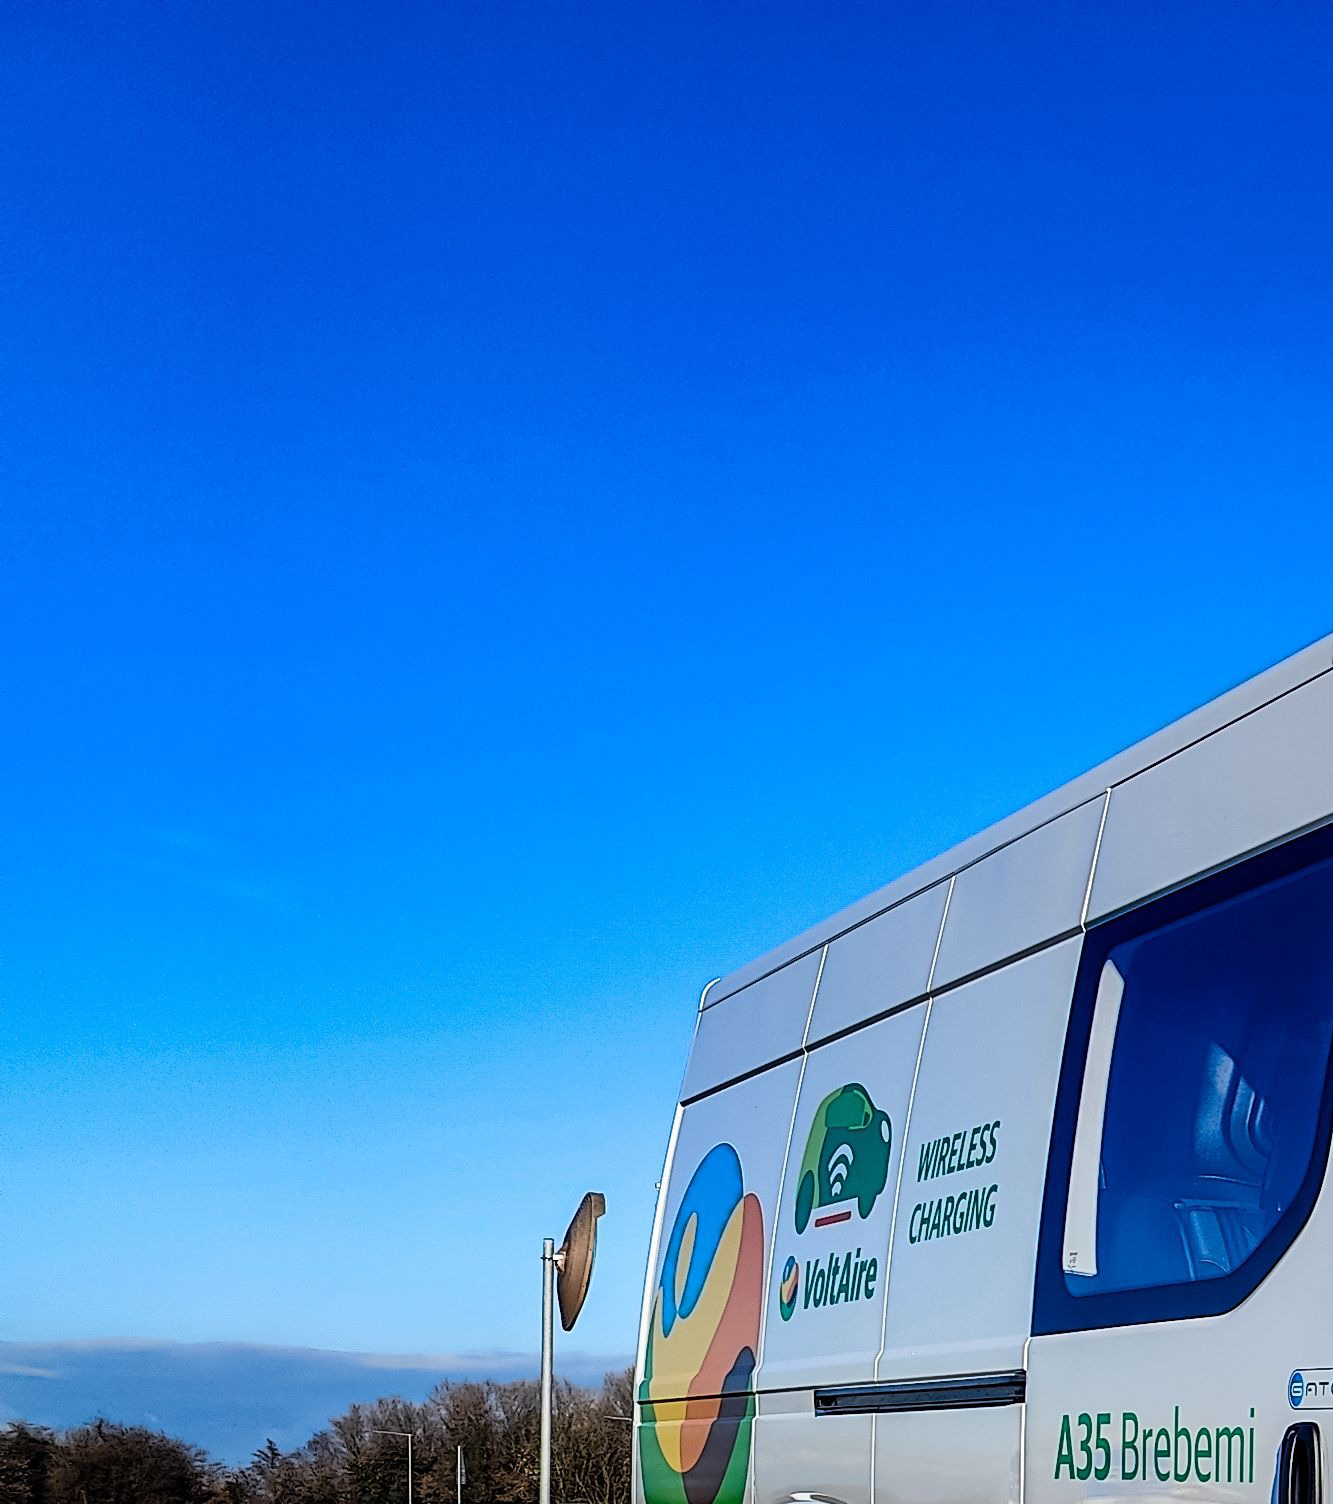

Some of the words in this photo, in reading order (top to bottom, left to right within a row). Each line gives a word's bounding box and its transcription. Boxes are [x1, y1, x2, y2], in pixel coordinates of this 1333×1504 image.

[917, 1121, 1000, 1182] WIRELESS
[909, 1185, 998, 1244] CHARGING
[803, 1248, 878, 1309] VoltAire
[1054, 1412, 1112, 1480] A35
[1121, 1406, 1256, 1483] Brebemi
